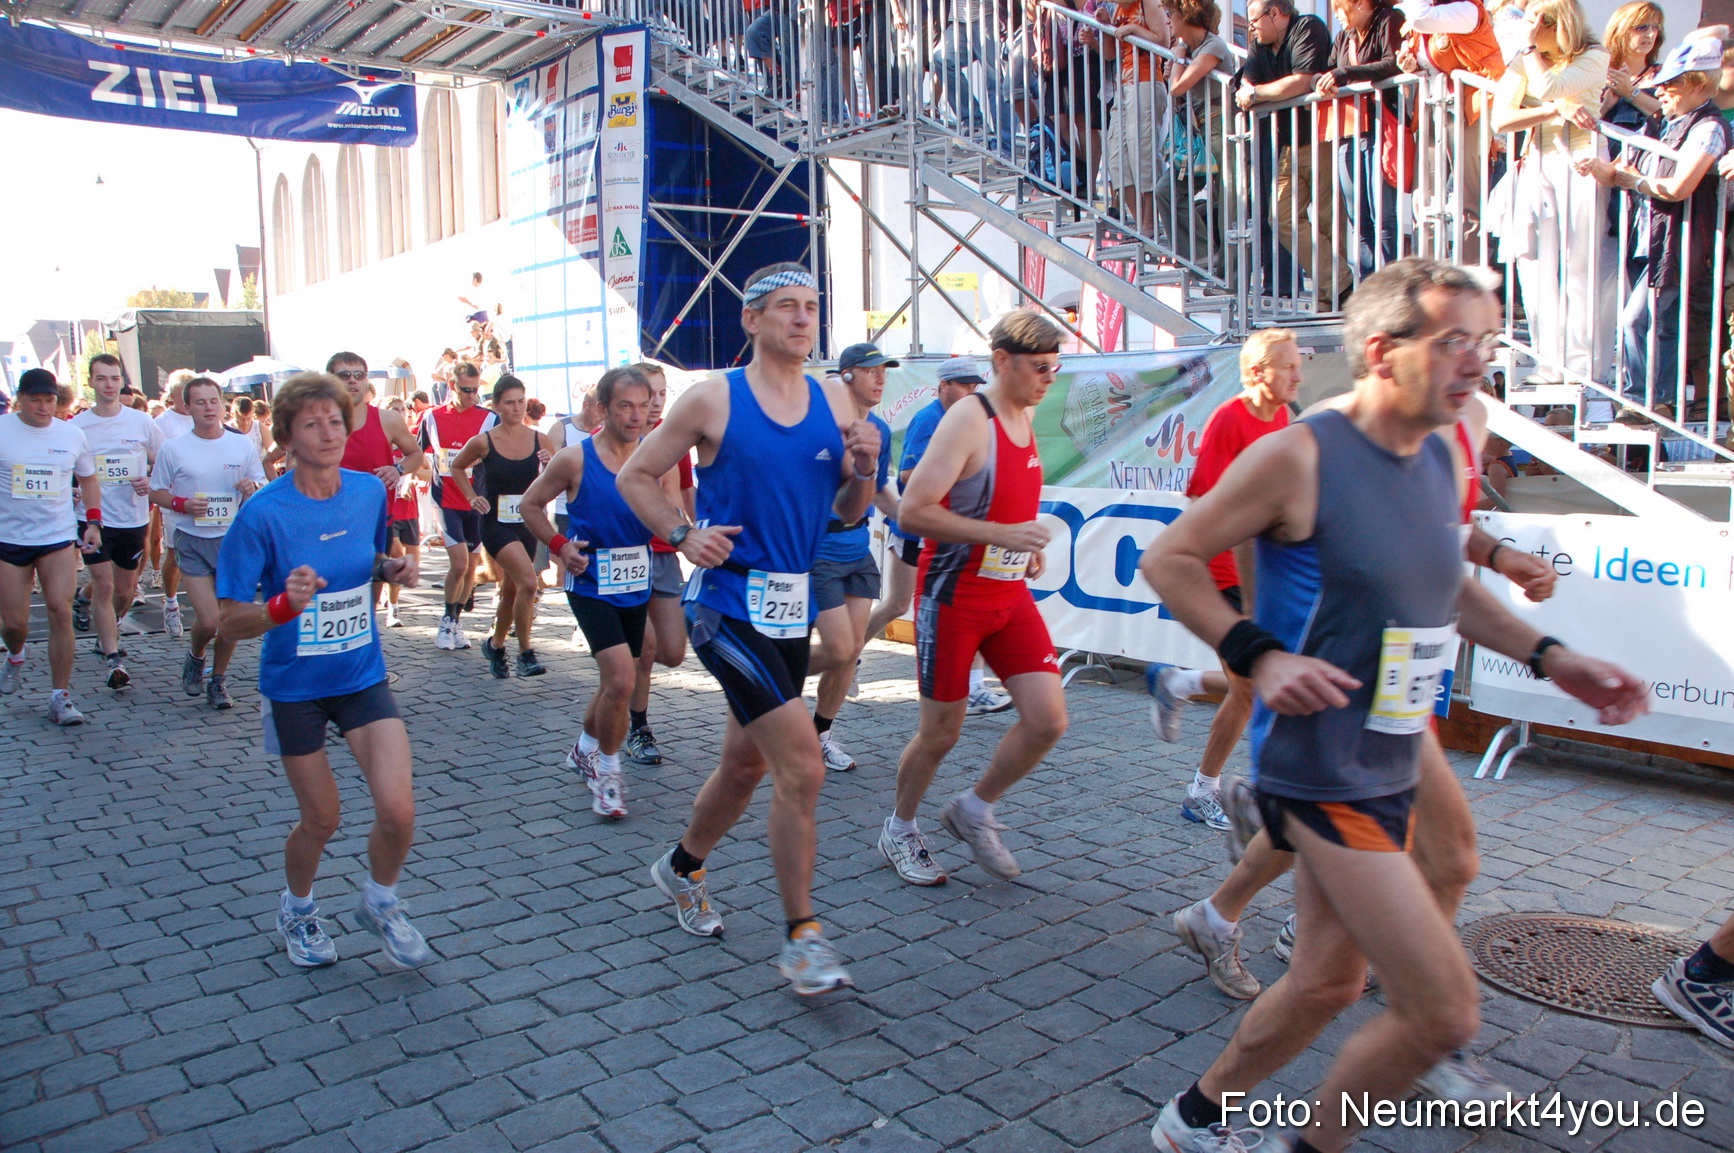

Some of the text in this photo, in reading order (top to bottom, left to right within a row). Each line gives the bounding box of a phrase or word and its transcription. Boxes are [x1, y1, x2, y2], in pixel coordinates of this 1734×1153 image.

[88, 60, 238, 117] ZIEL
[335, 101, 401, 117] MIZUNO
[327, 122, 407, 132] www.mizunoeurope.com
[882, 387, 928, 424] Wasser
[1085, 376, 1108, 450] NEUMARKTER
[25, 468, 53, 476] Joachim
[108, 467, 129, 477] 536
[26, 479, 48, 490] 611
[207, 506, 228, 517] 613
[611, 552, 640, 561] Hartmut
[601, 565, 646, 581] B 2152
[1594, 544, 1706, 588] Ideen
[768, 580, 794, 592] Peter
[320, 595, 363, 613] Gabriele
[751, 594, 804, 620] B 2748
[303, 612, 368, 639] A 2076
